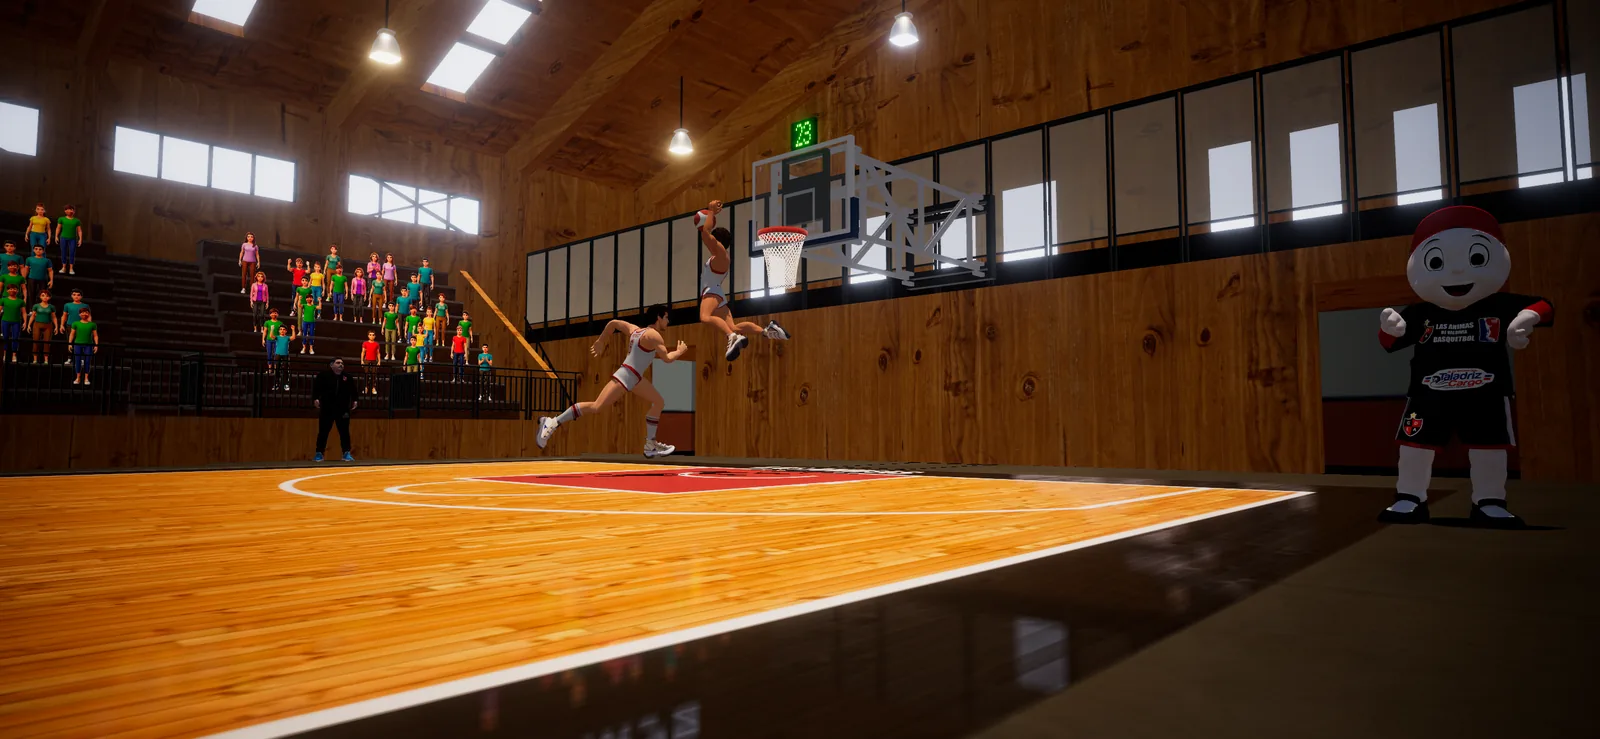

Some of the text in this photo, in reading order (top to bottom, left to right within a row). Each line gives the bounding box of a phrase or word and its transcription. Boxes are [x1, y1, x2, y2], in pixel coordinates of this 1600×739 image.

[796, 121, 811, 147] 23
[1433, 335, 1475, 343] BASQUETBOL
[1439, 372, 1482, 381] Taladriz
[1448, 380, 1483, 388] Cargo
